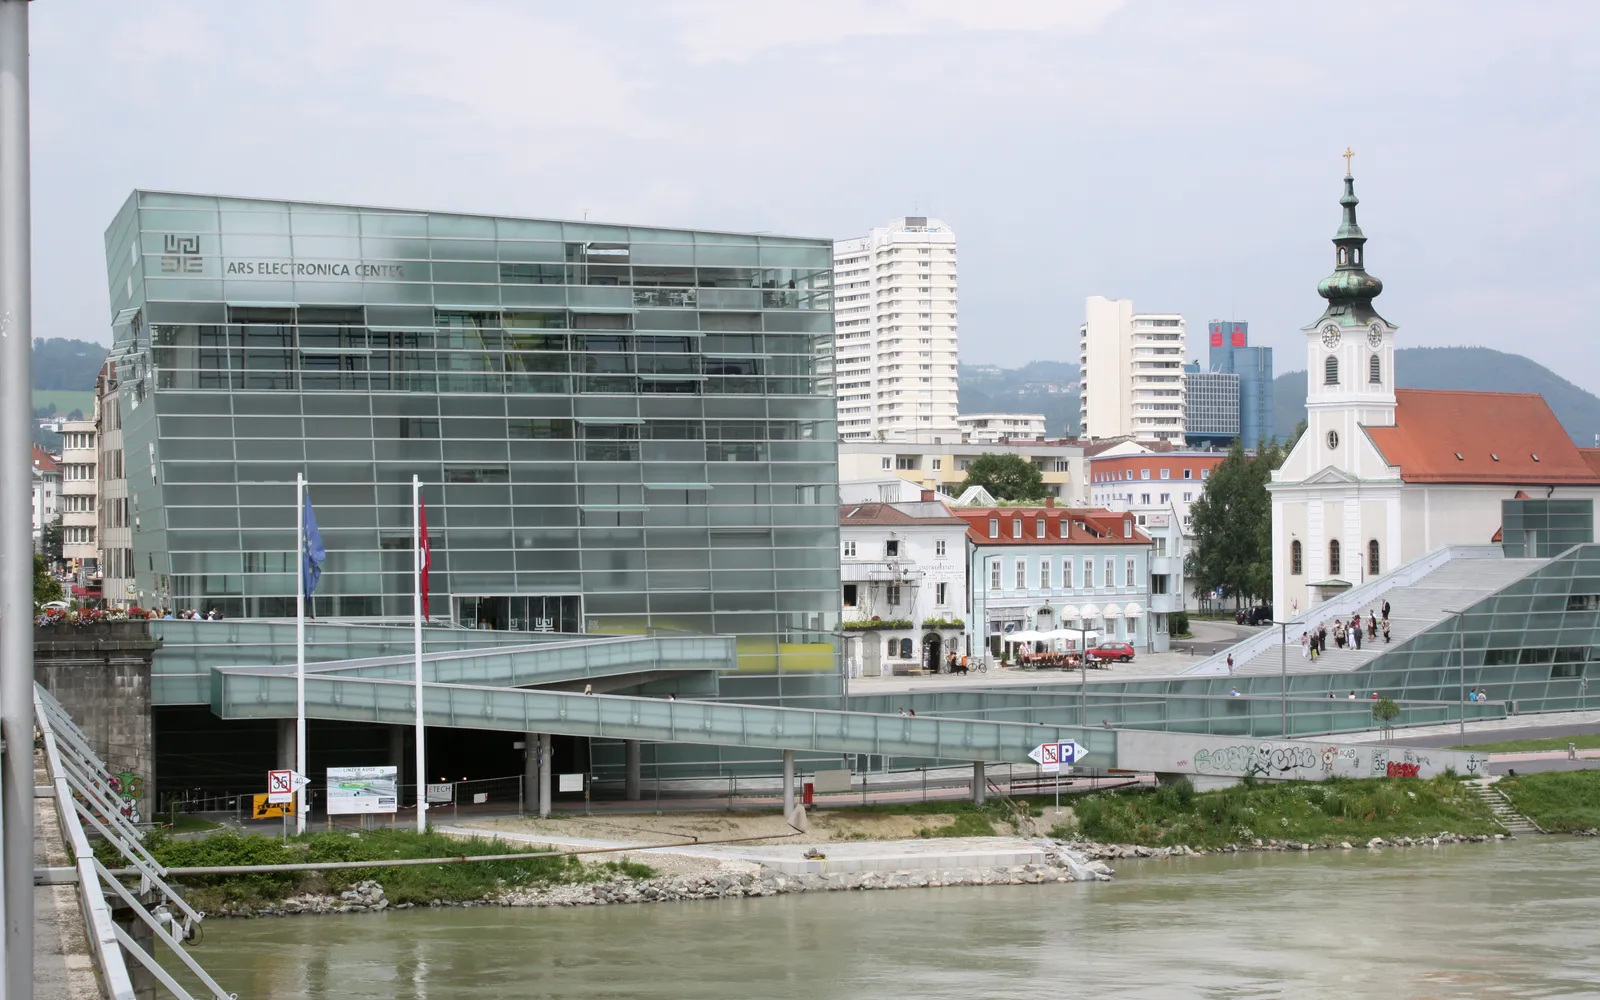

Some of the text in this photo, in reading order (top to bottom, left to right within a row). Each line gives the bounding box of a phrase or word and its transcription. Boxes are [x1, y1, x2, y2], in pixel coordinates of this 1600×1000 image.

[227, 262, 405, 277] ARS ELECTRONICA CENTER
[1061, 745, 1073, 761] P
[1374, 759, 1386, 771] 35
[273, 776, 288, 790] 35
[294, 777, 304, 786] 40
[429, 785, 451, 793] ETECH
